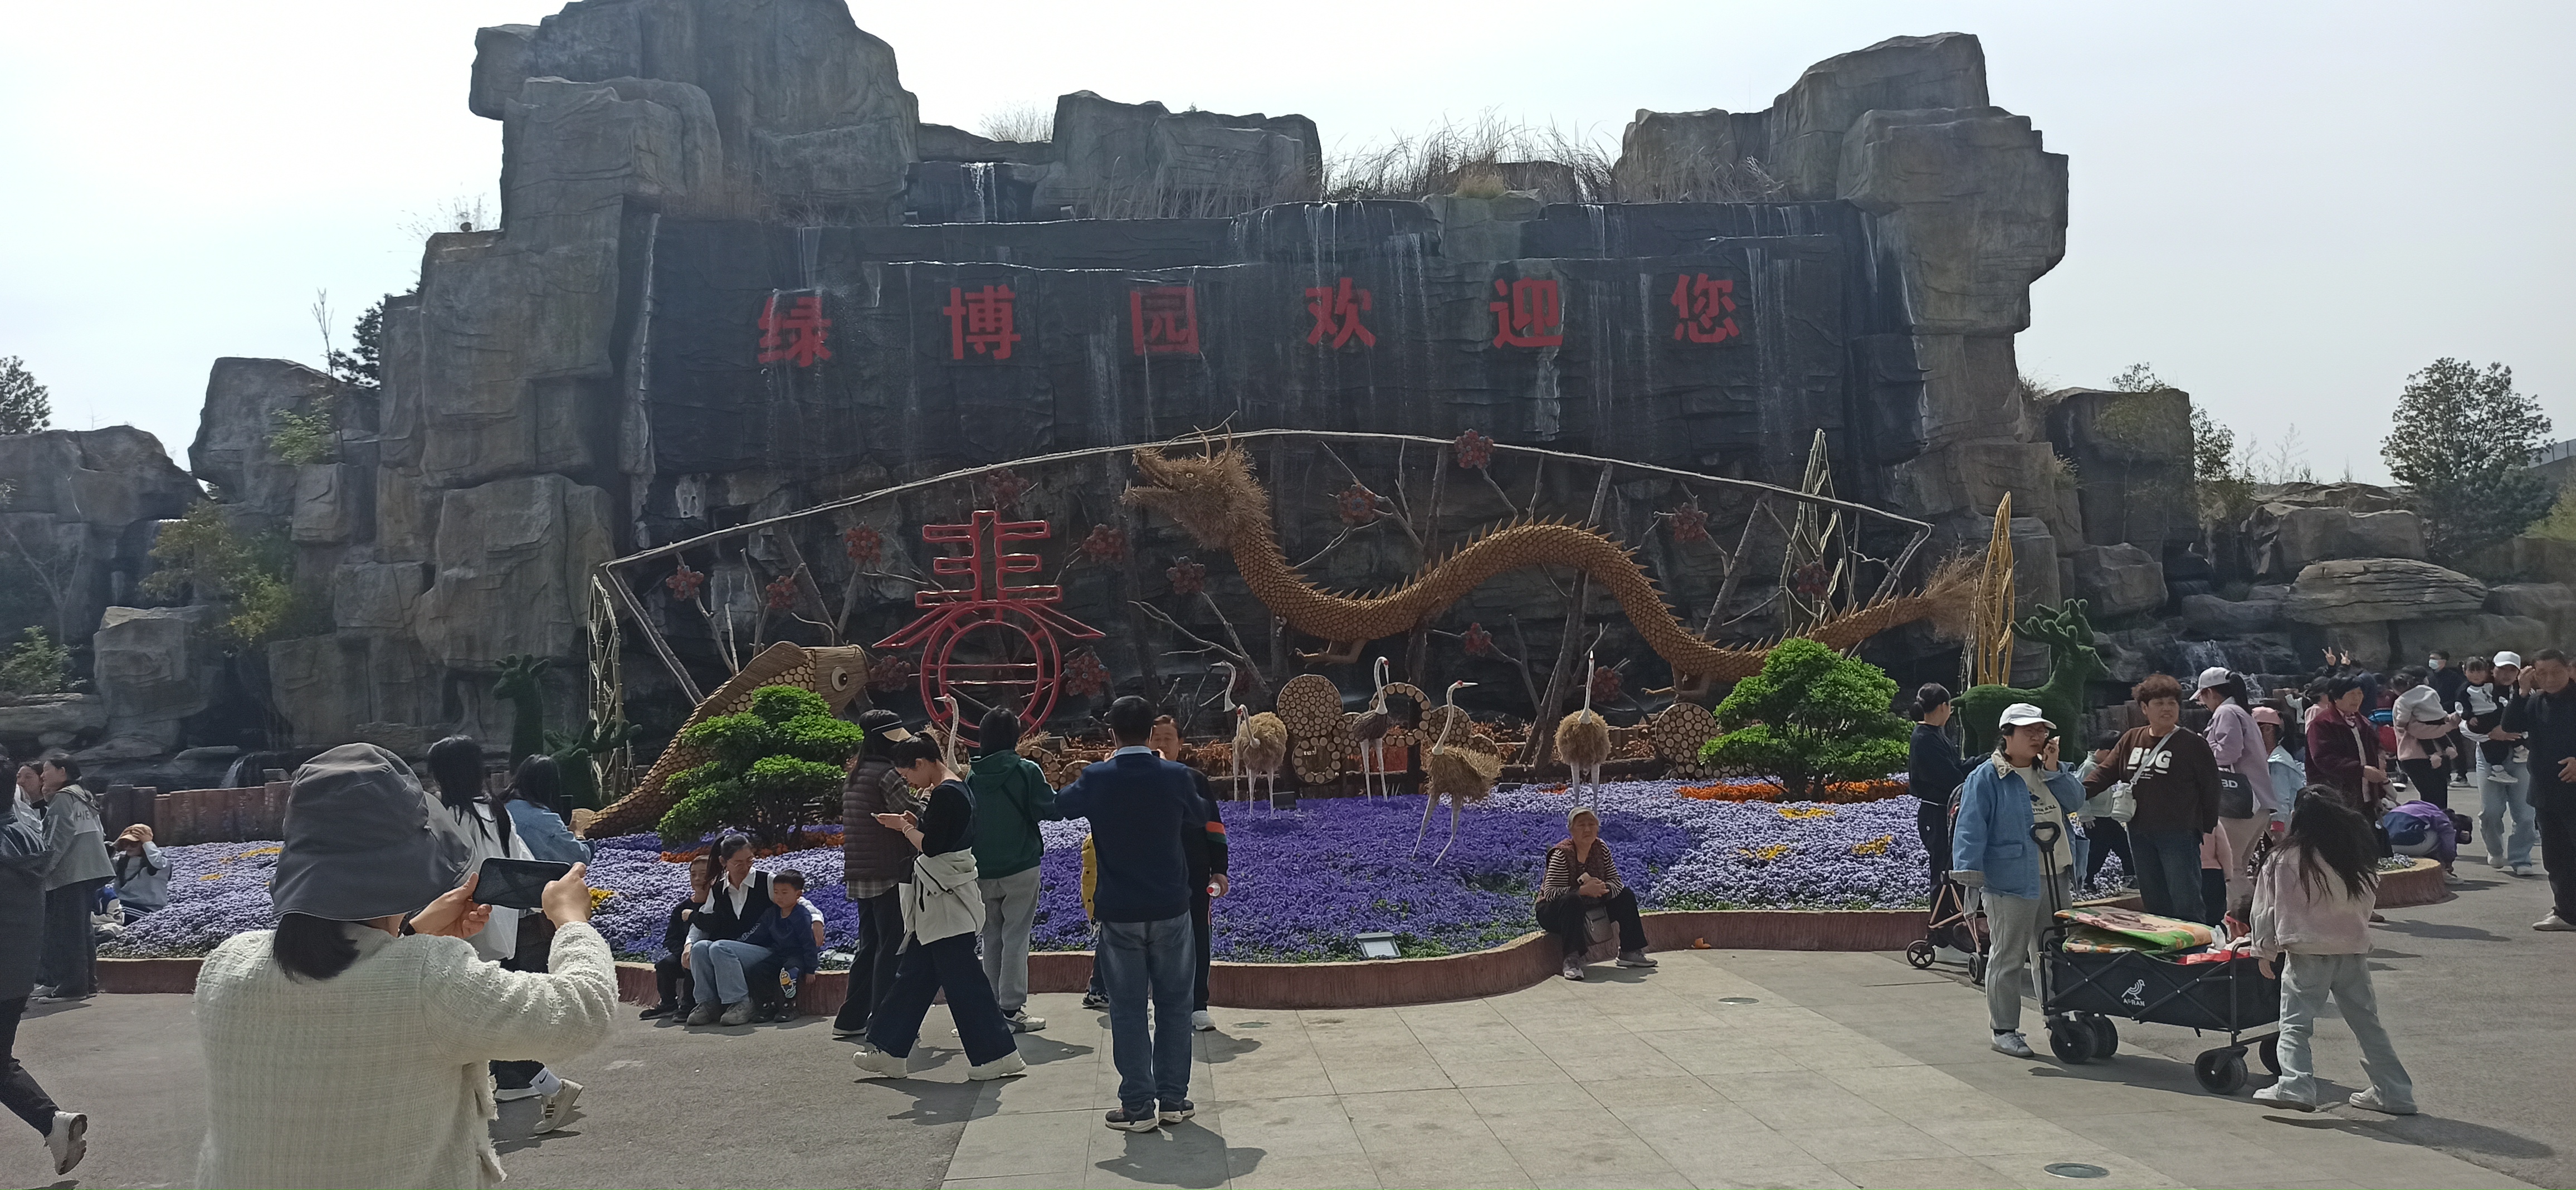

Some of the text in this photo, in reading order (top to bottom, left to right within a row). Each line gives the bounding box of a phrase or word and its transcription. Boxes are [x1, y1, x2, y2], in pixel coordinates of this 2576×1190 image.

[758, 272, 1739, 368] 绿博园欢迎您
